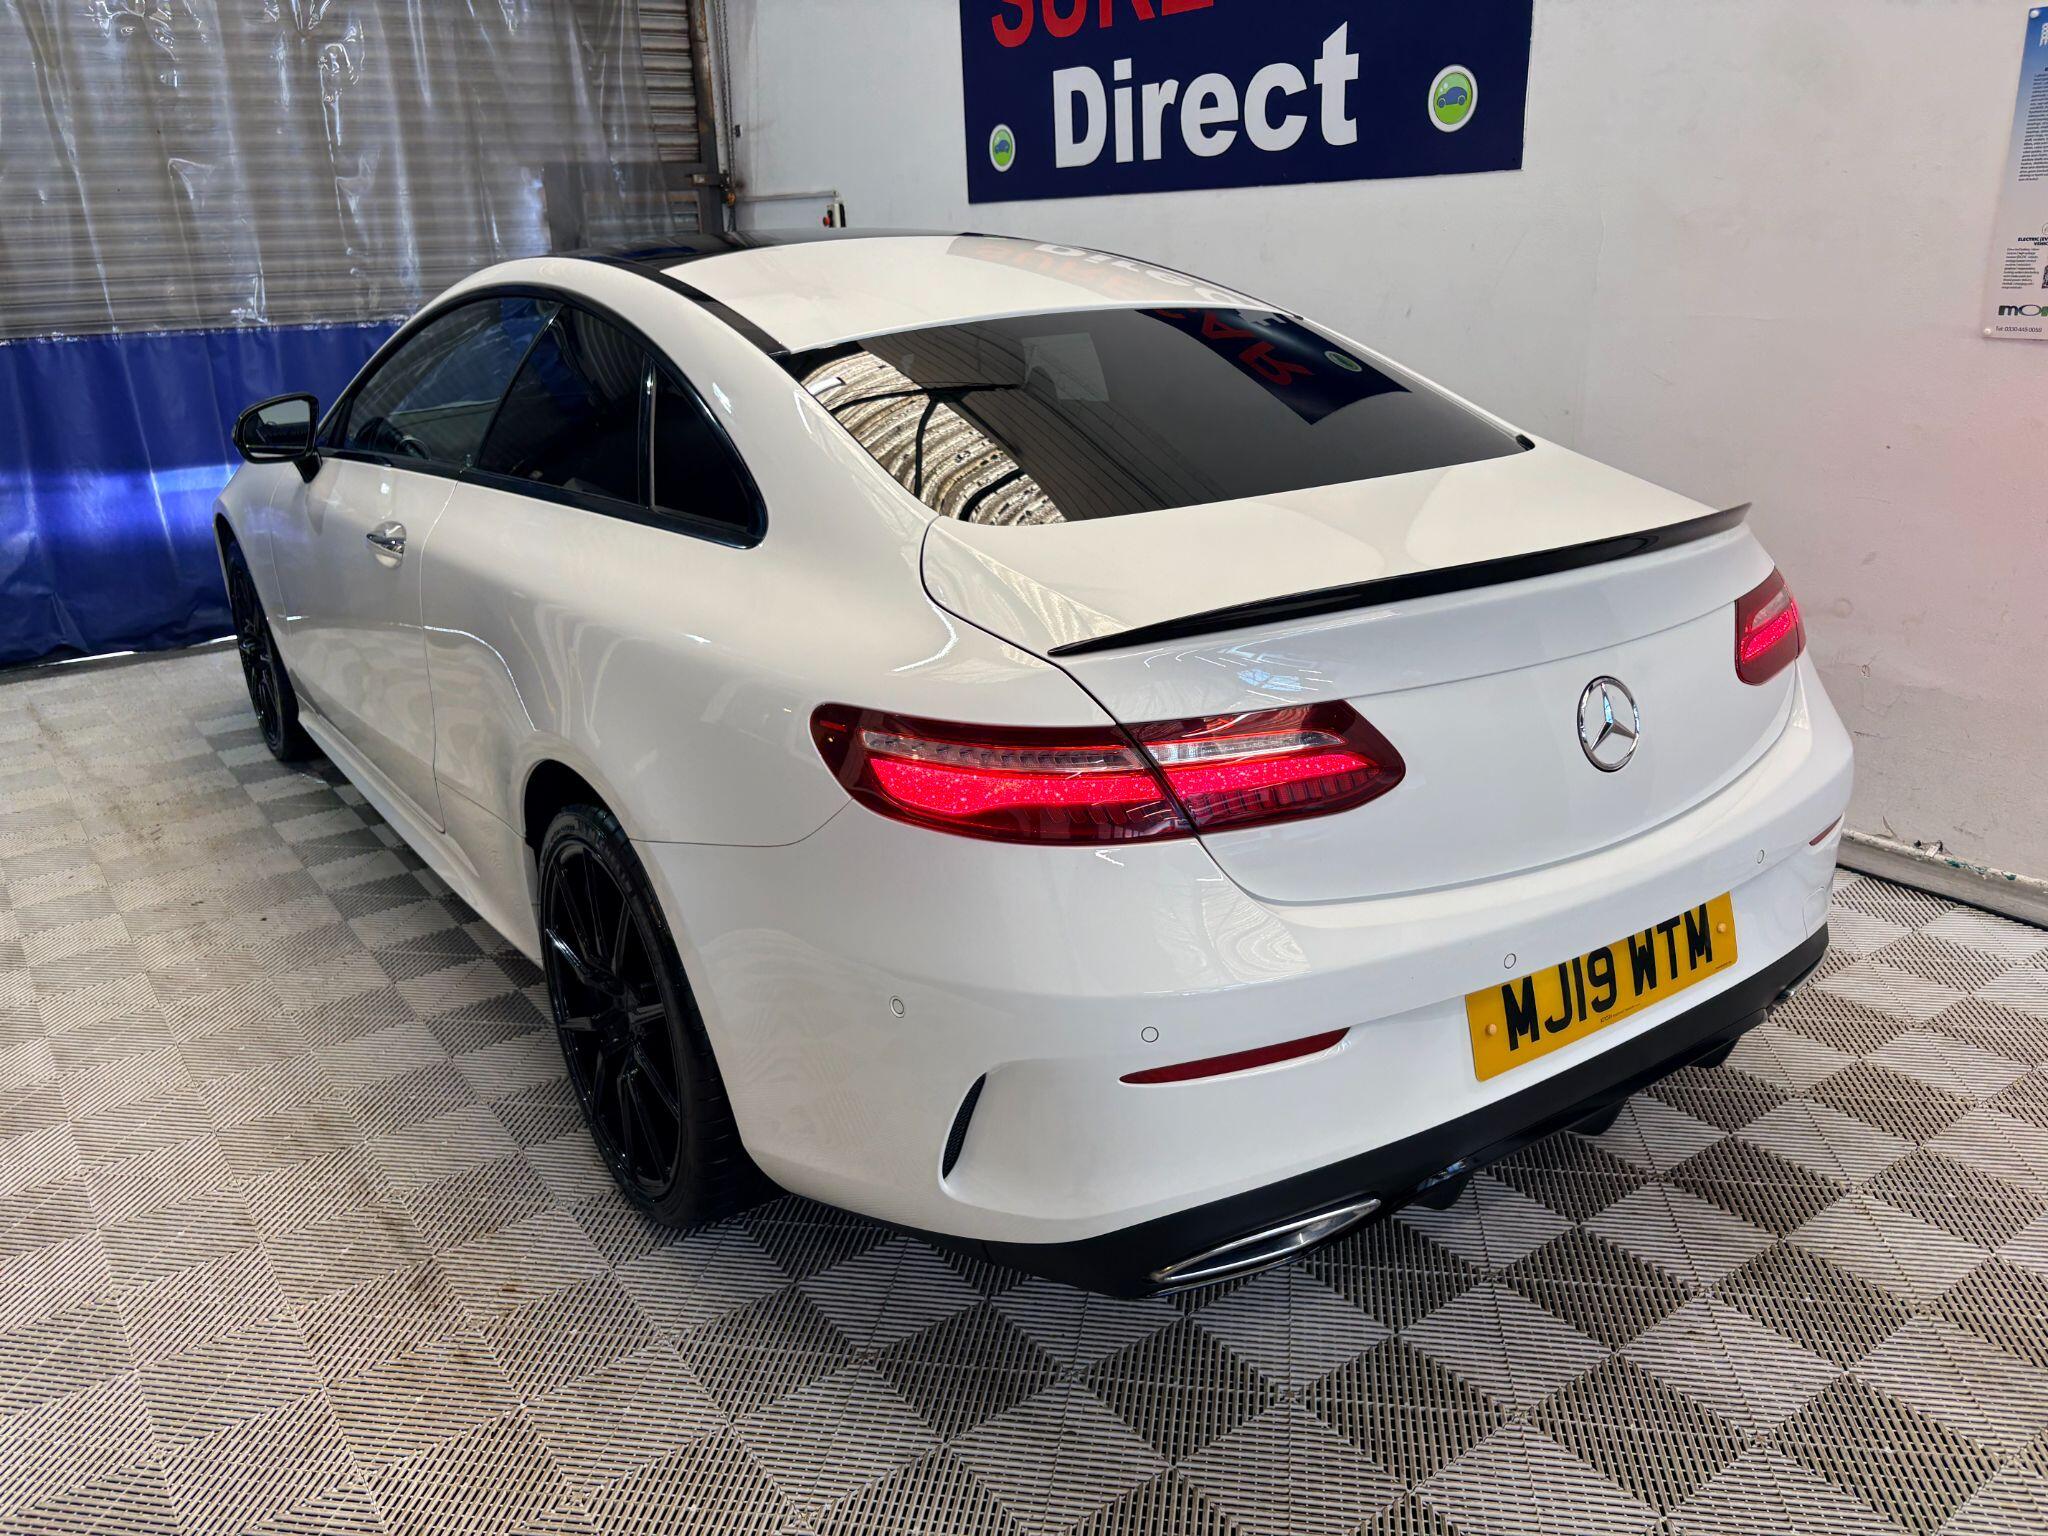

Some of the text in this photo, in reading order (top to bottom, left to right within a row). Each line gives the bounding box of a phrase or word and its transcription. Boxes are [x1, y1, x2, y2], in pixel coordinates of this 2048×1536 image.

[1053, 21, 1360, 168] Direct
[1501, 903, 1713, 1051] MJ19 WTM
